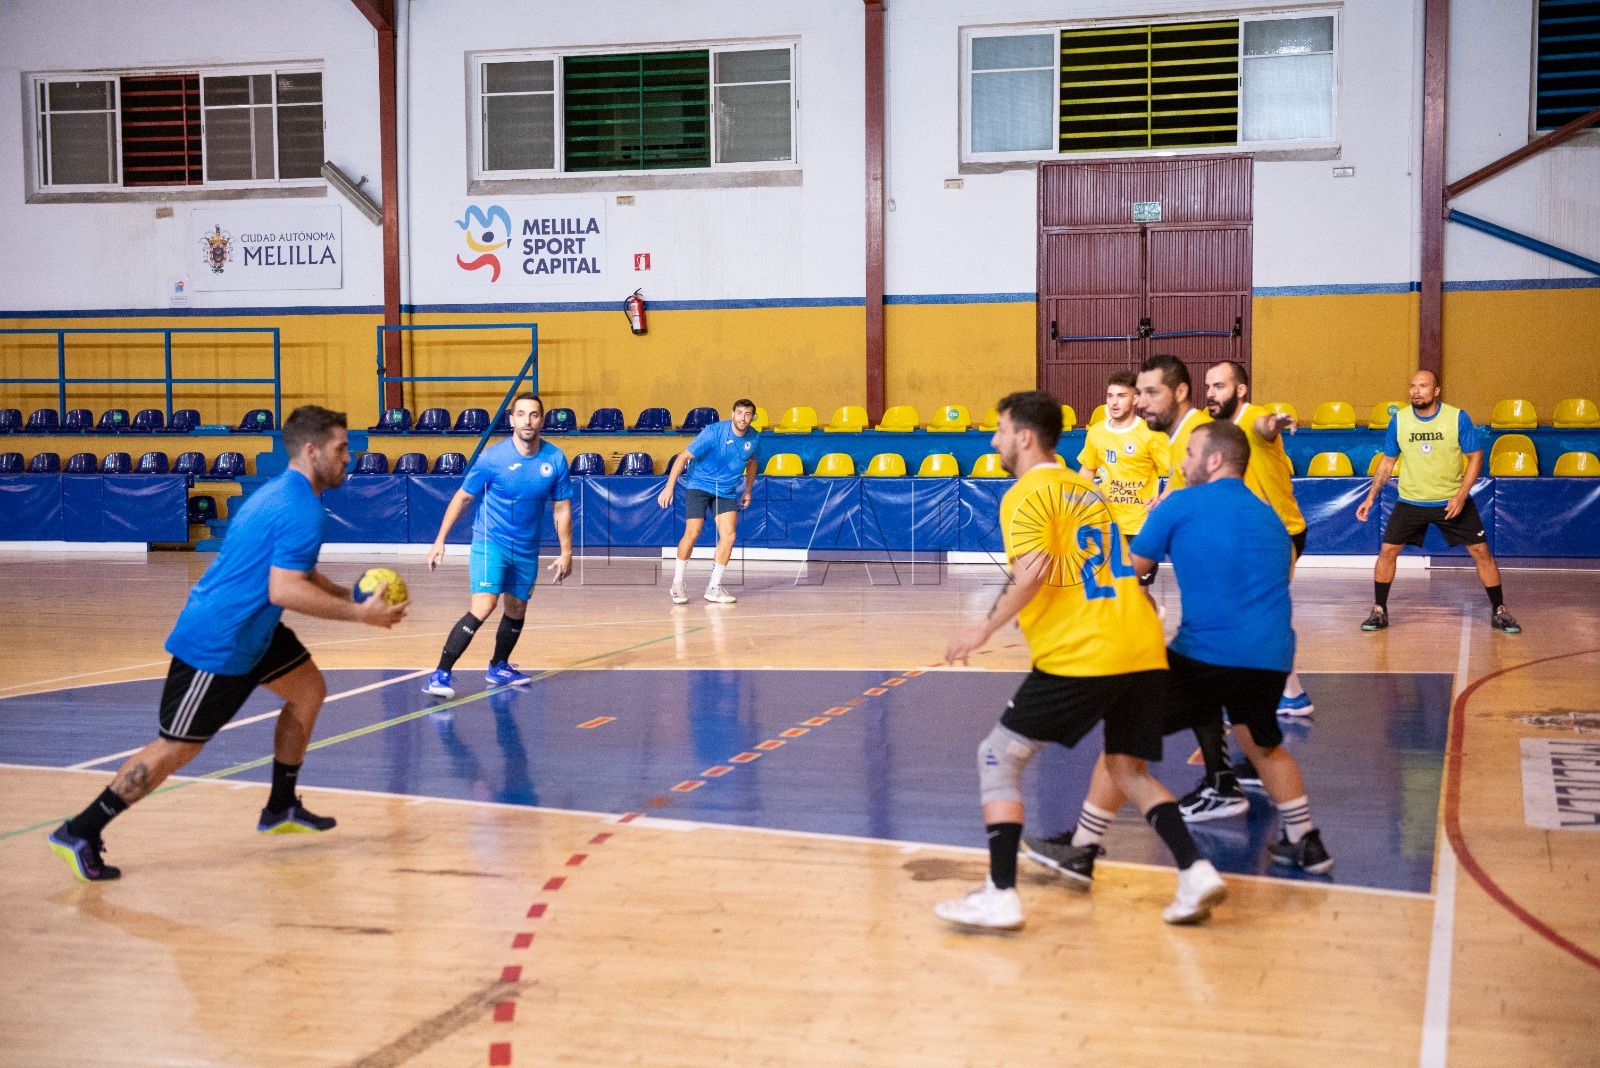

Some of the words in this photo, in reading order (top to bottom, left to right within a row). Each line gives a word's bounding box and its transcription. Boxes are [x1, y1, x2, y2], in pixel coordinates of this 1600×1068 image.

[522, 218, 600, 236] MELILLA
[240, 233, 276, 243] CIUDAD
[279, 230, 336, 242] AUTÓNOMA
[522, 237, 586, 255] SPORT
[243, 245, 336, 266] MELILLA
[522, 257, 601, 275] CAPITAL
[1105, 449, 1117, 464] 10
